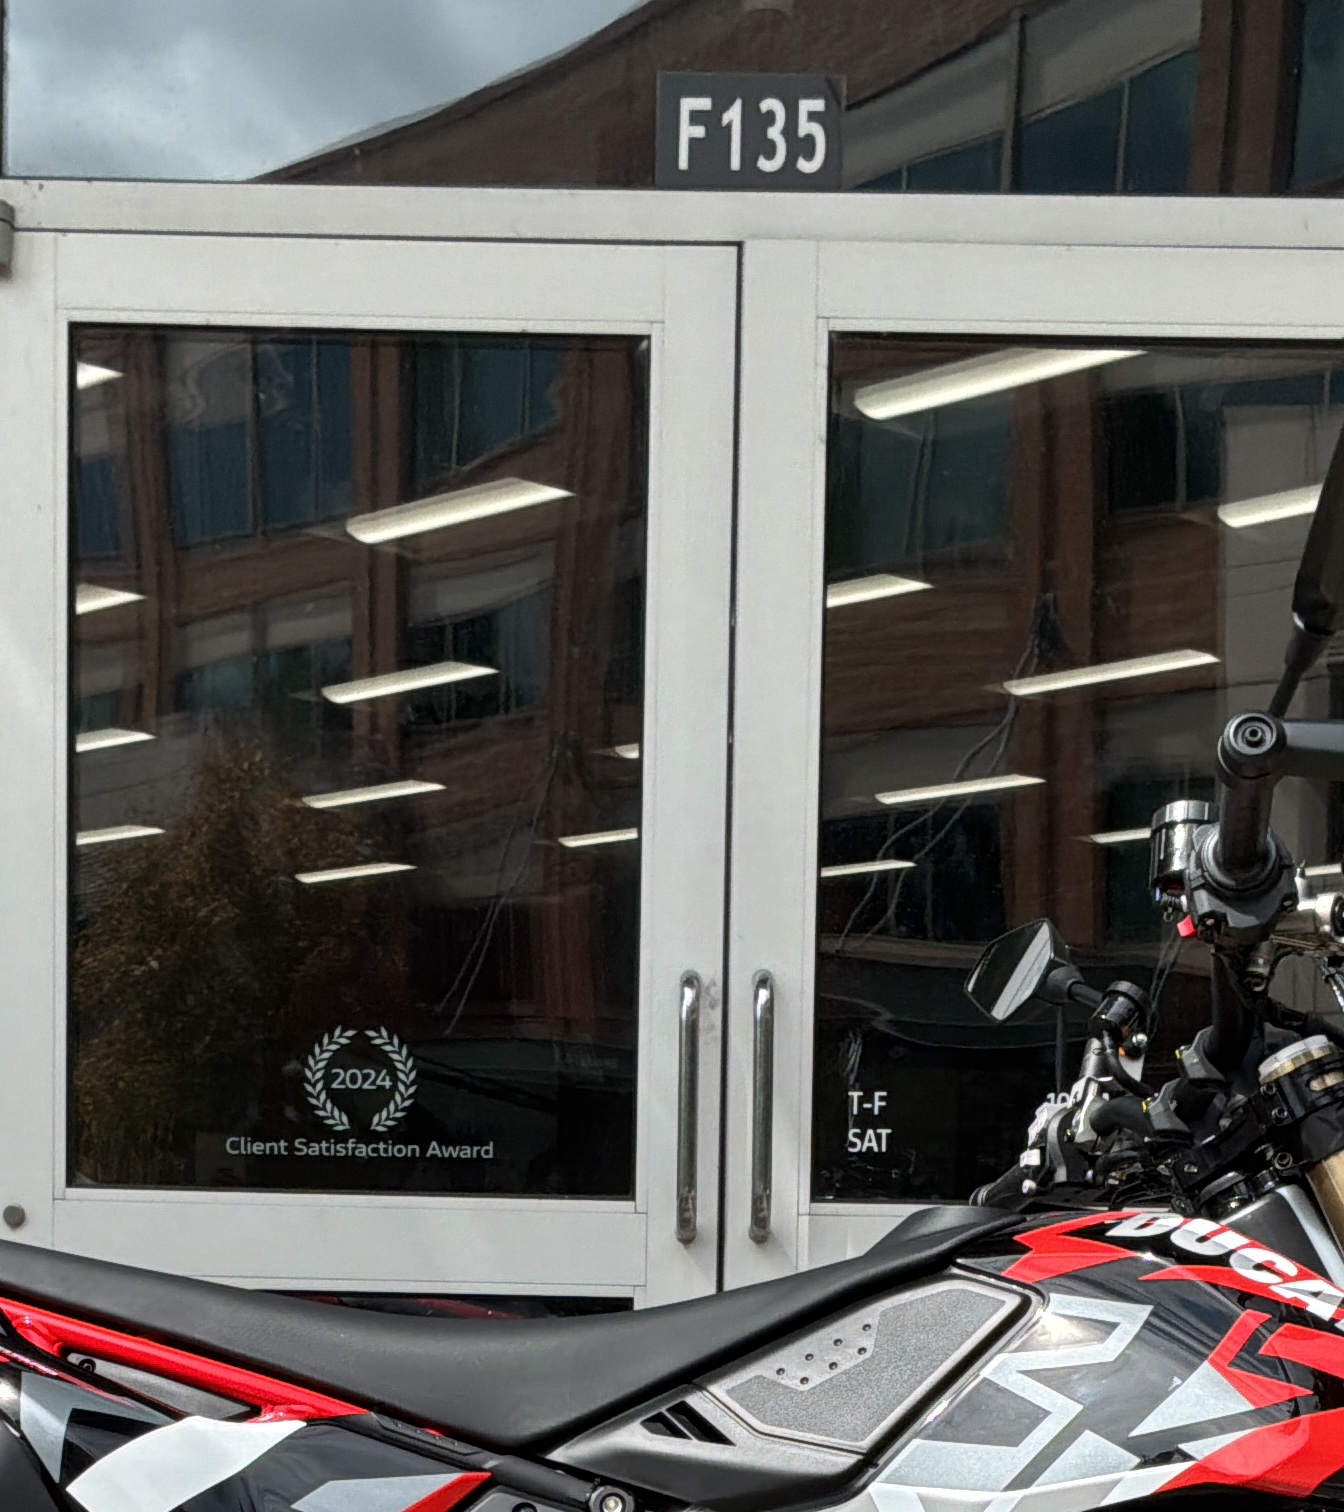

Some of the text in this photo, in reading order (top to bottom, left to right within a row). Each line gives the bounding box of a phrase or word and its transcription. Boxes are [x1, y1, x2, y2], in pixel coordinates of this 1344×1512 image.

[677, 97, 827, 174] F135
[329, 1068, 393, 1090] 2024
[847, 1091, 888, 1116] T-F
[225, 1136, 494, 1159] Client Satisfaction Award
[847, 1128, 892, 1153] SAT
